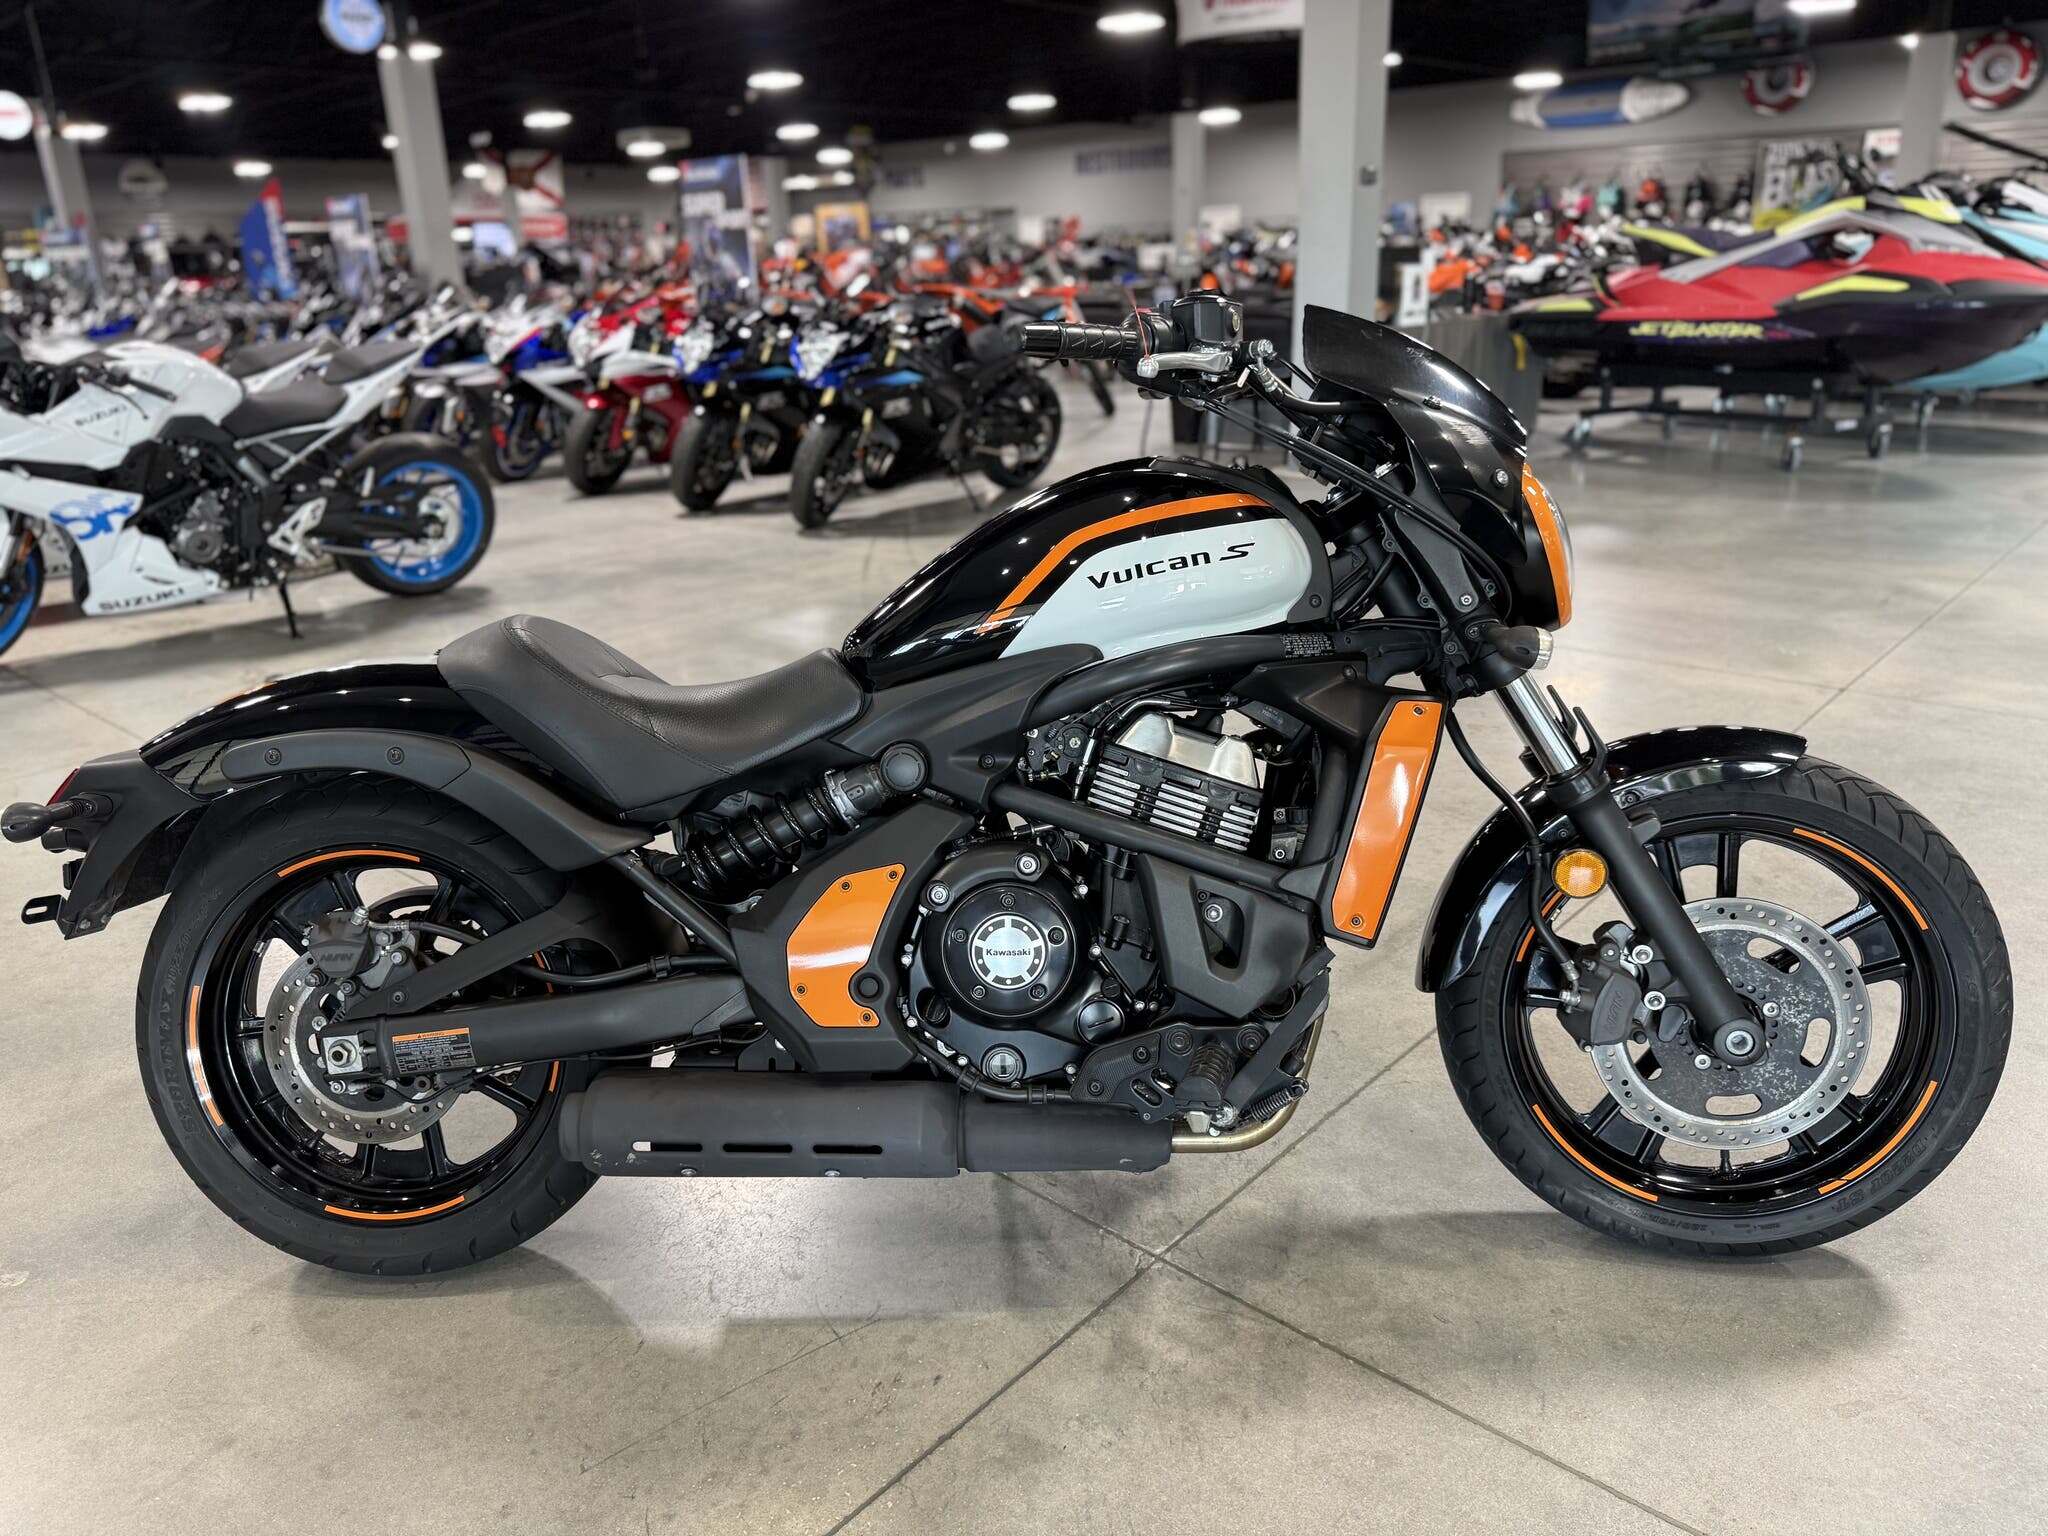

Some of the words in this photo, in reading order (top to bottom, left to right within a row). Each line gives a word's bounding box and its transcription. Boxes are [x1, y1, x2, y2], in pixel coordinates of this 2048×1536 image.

[1087, 551, 1211, 589] Vulcan
[1219, 542, 1255, 561] S
[98, 588, 185, 611] SUZUKI
[986, 948, 1031, 956] Kawasaki
